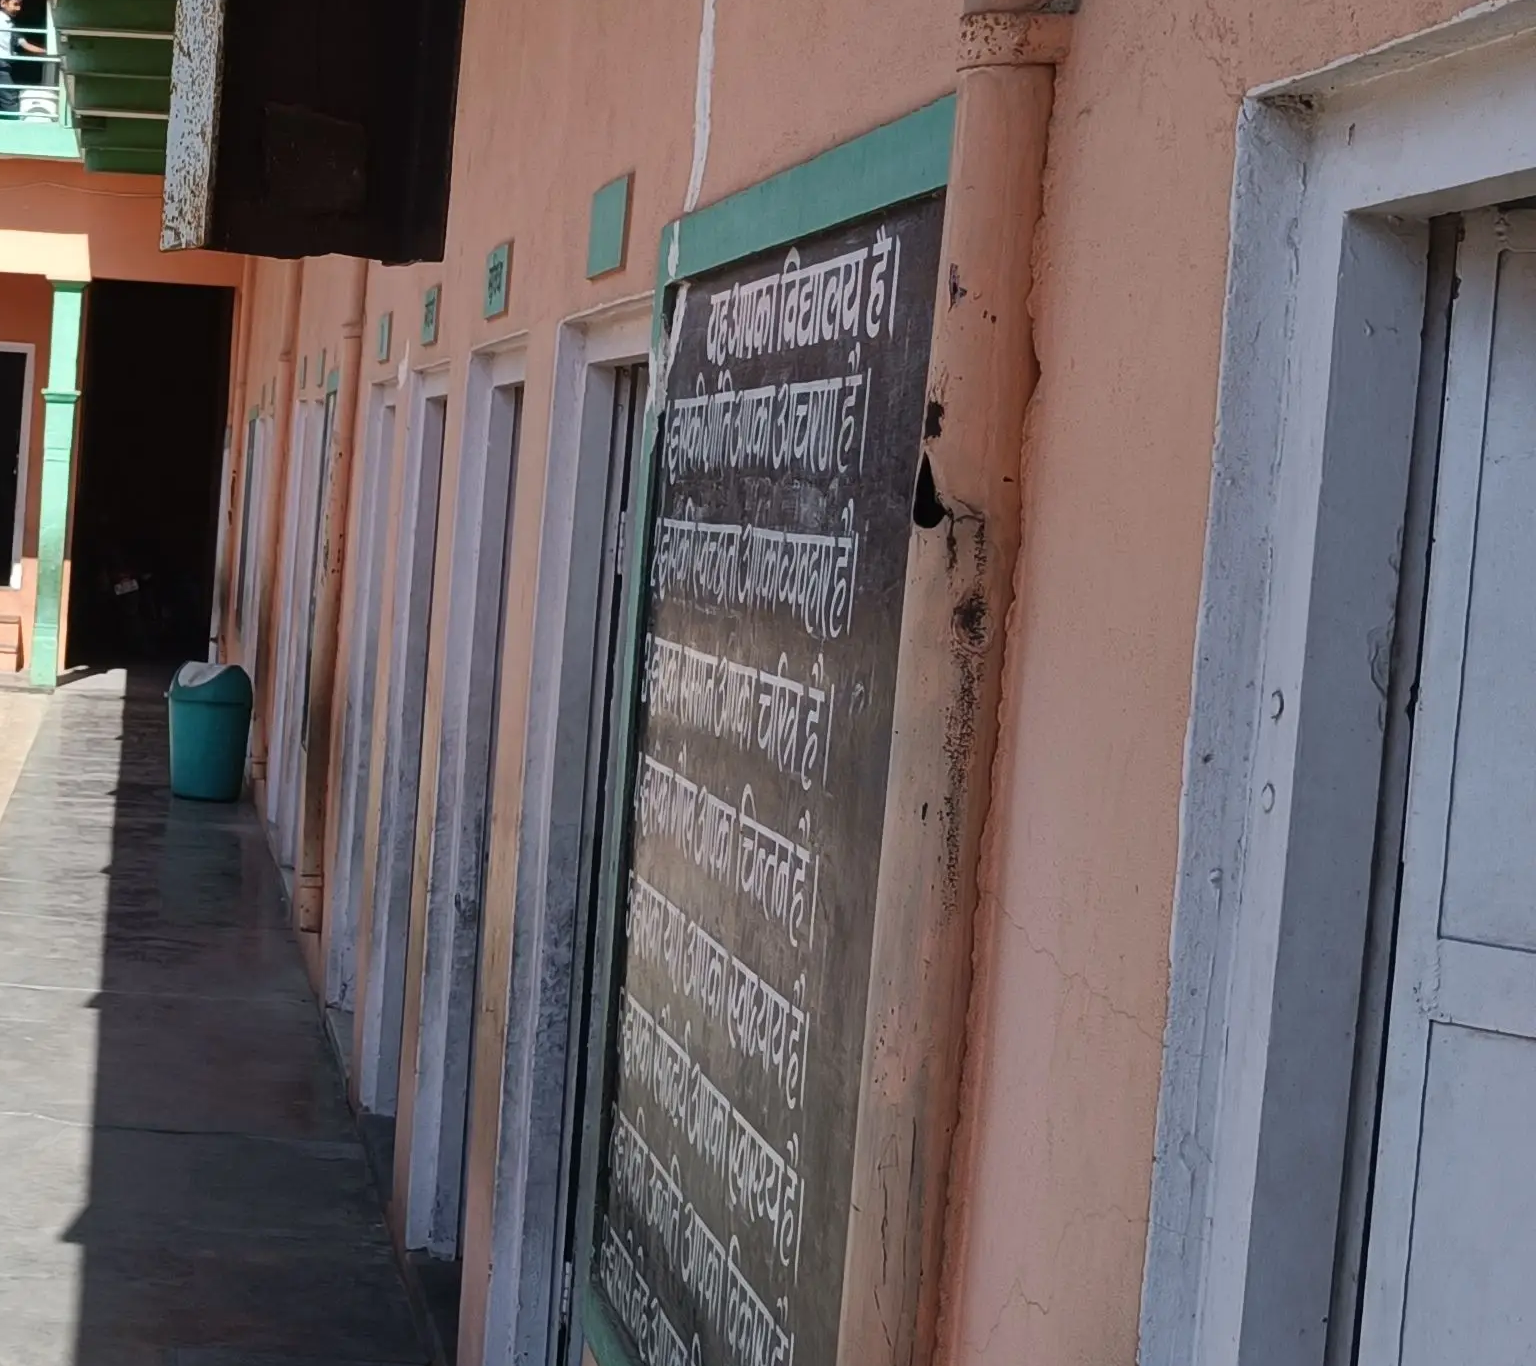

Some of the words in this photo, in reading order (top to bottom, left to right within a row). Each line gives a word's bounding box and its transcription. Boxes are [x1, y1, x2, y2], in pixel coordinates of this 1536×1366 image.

[705, 288, 732, 366] यह
[727, 272, 780, 359] आपका
[776, 247, 868, 350] विद्यालय
[701, 369, 736, 478] शांति
[728, 384, 776, 468] आपका
[771, 376, 843, 472] आचरण
[689, 521, 742, 612] स्वच्छता
[736, 522, 784, 612] आपका
[777, 531, 836, 635] व्यवहार
[712, 655, 758, 750] आपका
[756, 651, 804, 773] चरित्र
[693, 785, 737, 884] आपका
[734, 783, 794, 924] चिन्तन
[682, 920, 729, 1025] आपका
[726, 955, 790, 1086] स्वाध्याय
[686, 1062, 731, 1178] आपका
[679, 1201, 726, 1333] आपका
